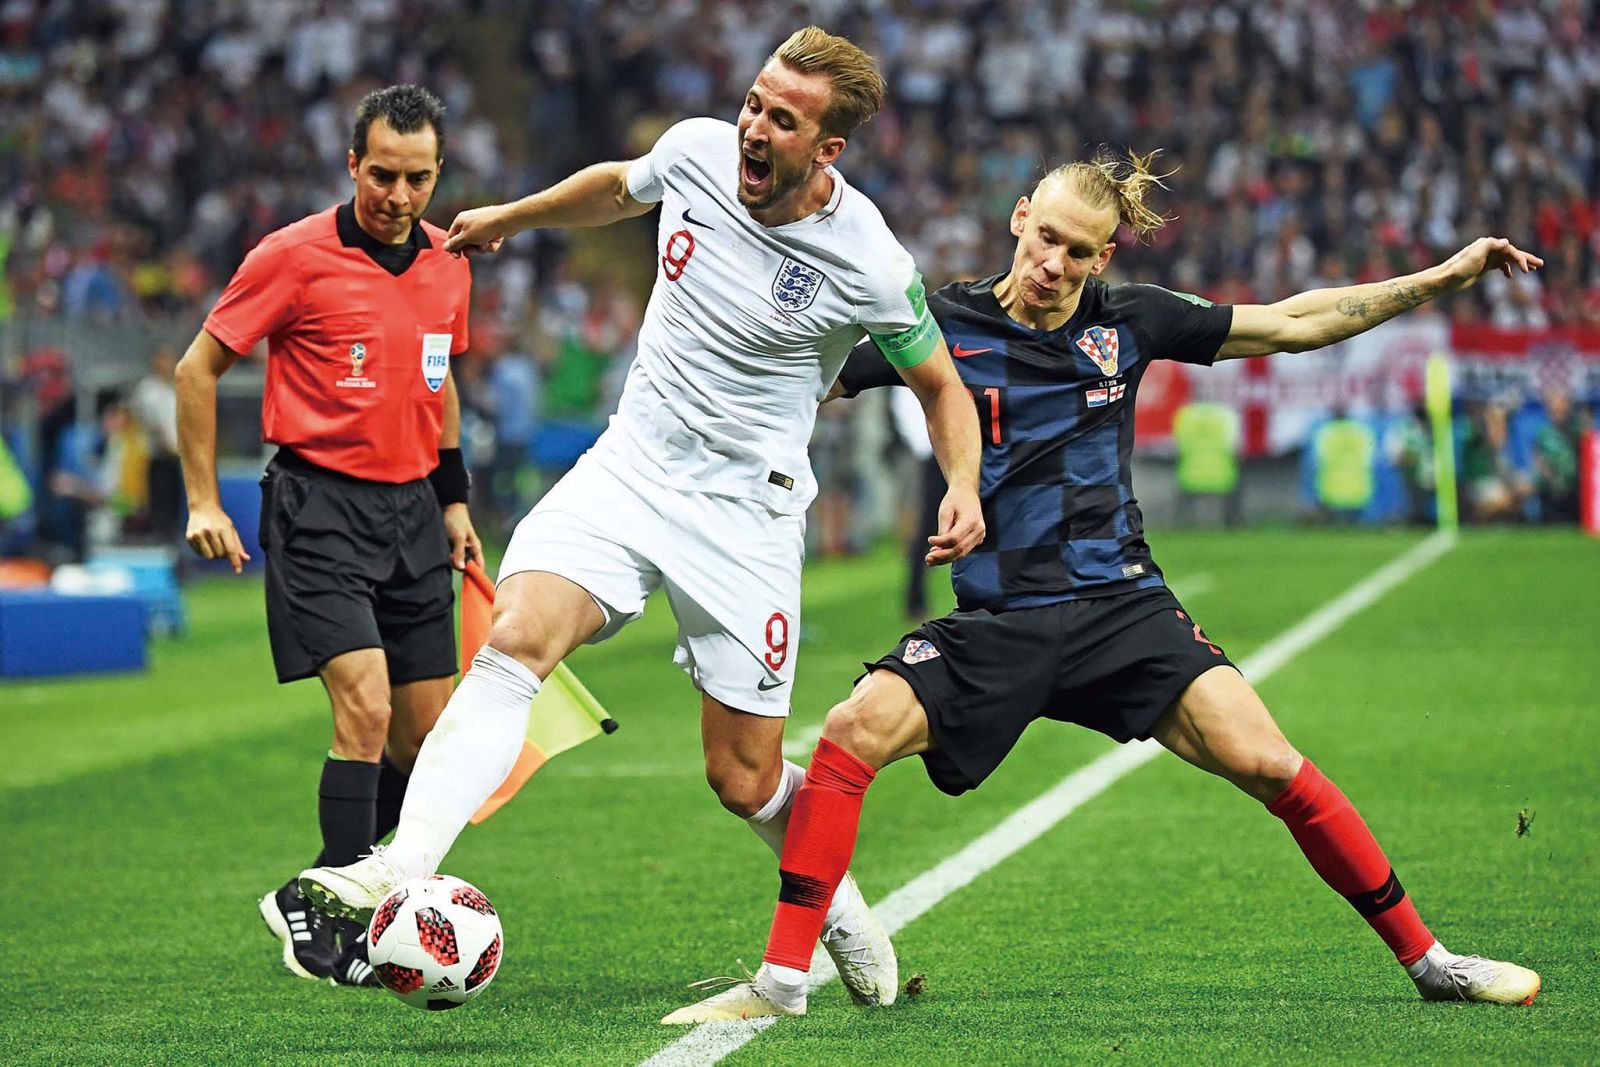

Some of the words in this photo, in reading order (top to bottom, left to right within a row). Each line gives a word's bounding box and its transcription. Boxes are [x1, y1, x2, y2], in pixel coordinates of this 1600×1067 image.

[662, 229, 695, 281] 9
[427, 355, 446, 366] FIFA
[765, 612, 788, 671] 9
[429, 985, 460, 994] adidas
